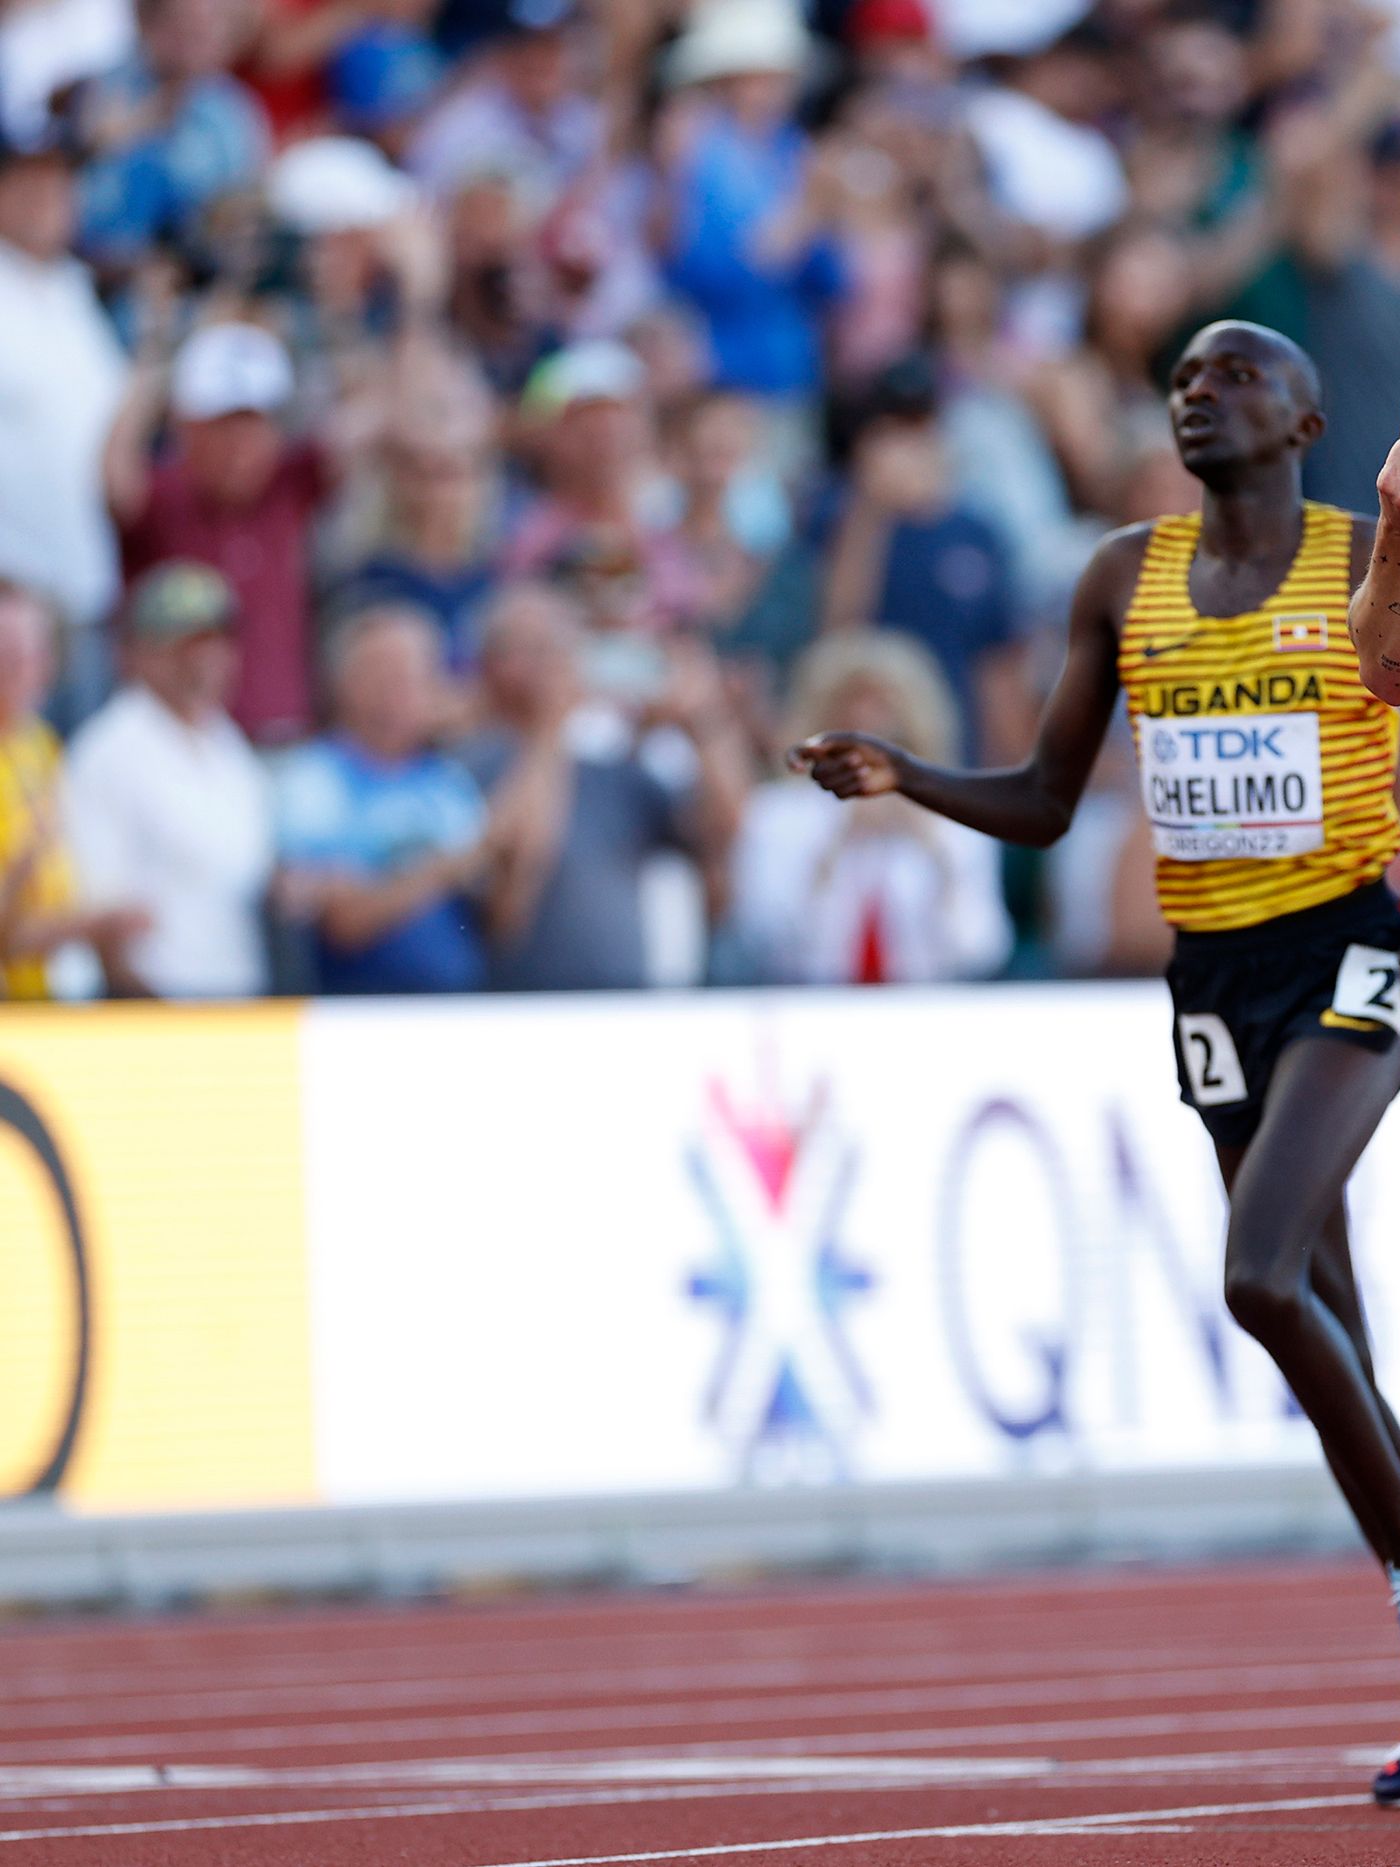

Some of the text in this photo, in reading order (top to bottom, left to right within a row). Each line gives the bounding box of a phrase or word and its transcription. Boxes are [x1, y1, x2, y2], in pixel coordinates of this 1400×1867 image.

[1145, 674, 1323, 718] UGANDA
[1180, 726, 1285, 761] TDK
[1152, 772, 1306, 818] CHELIMO
[1367, 967, 1396, 1010] 2
[1190, 1032, 1222, 1087] 2
